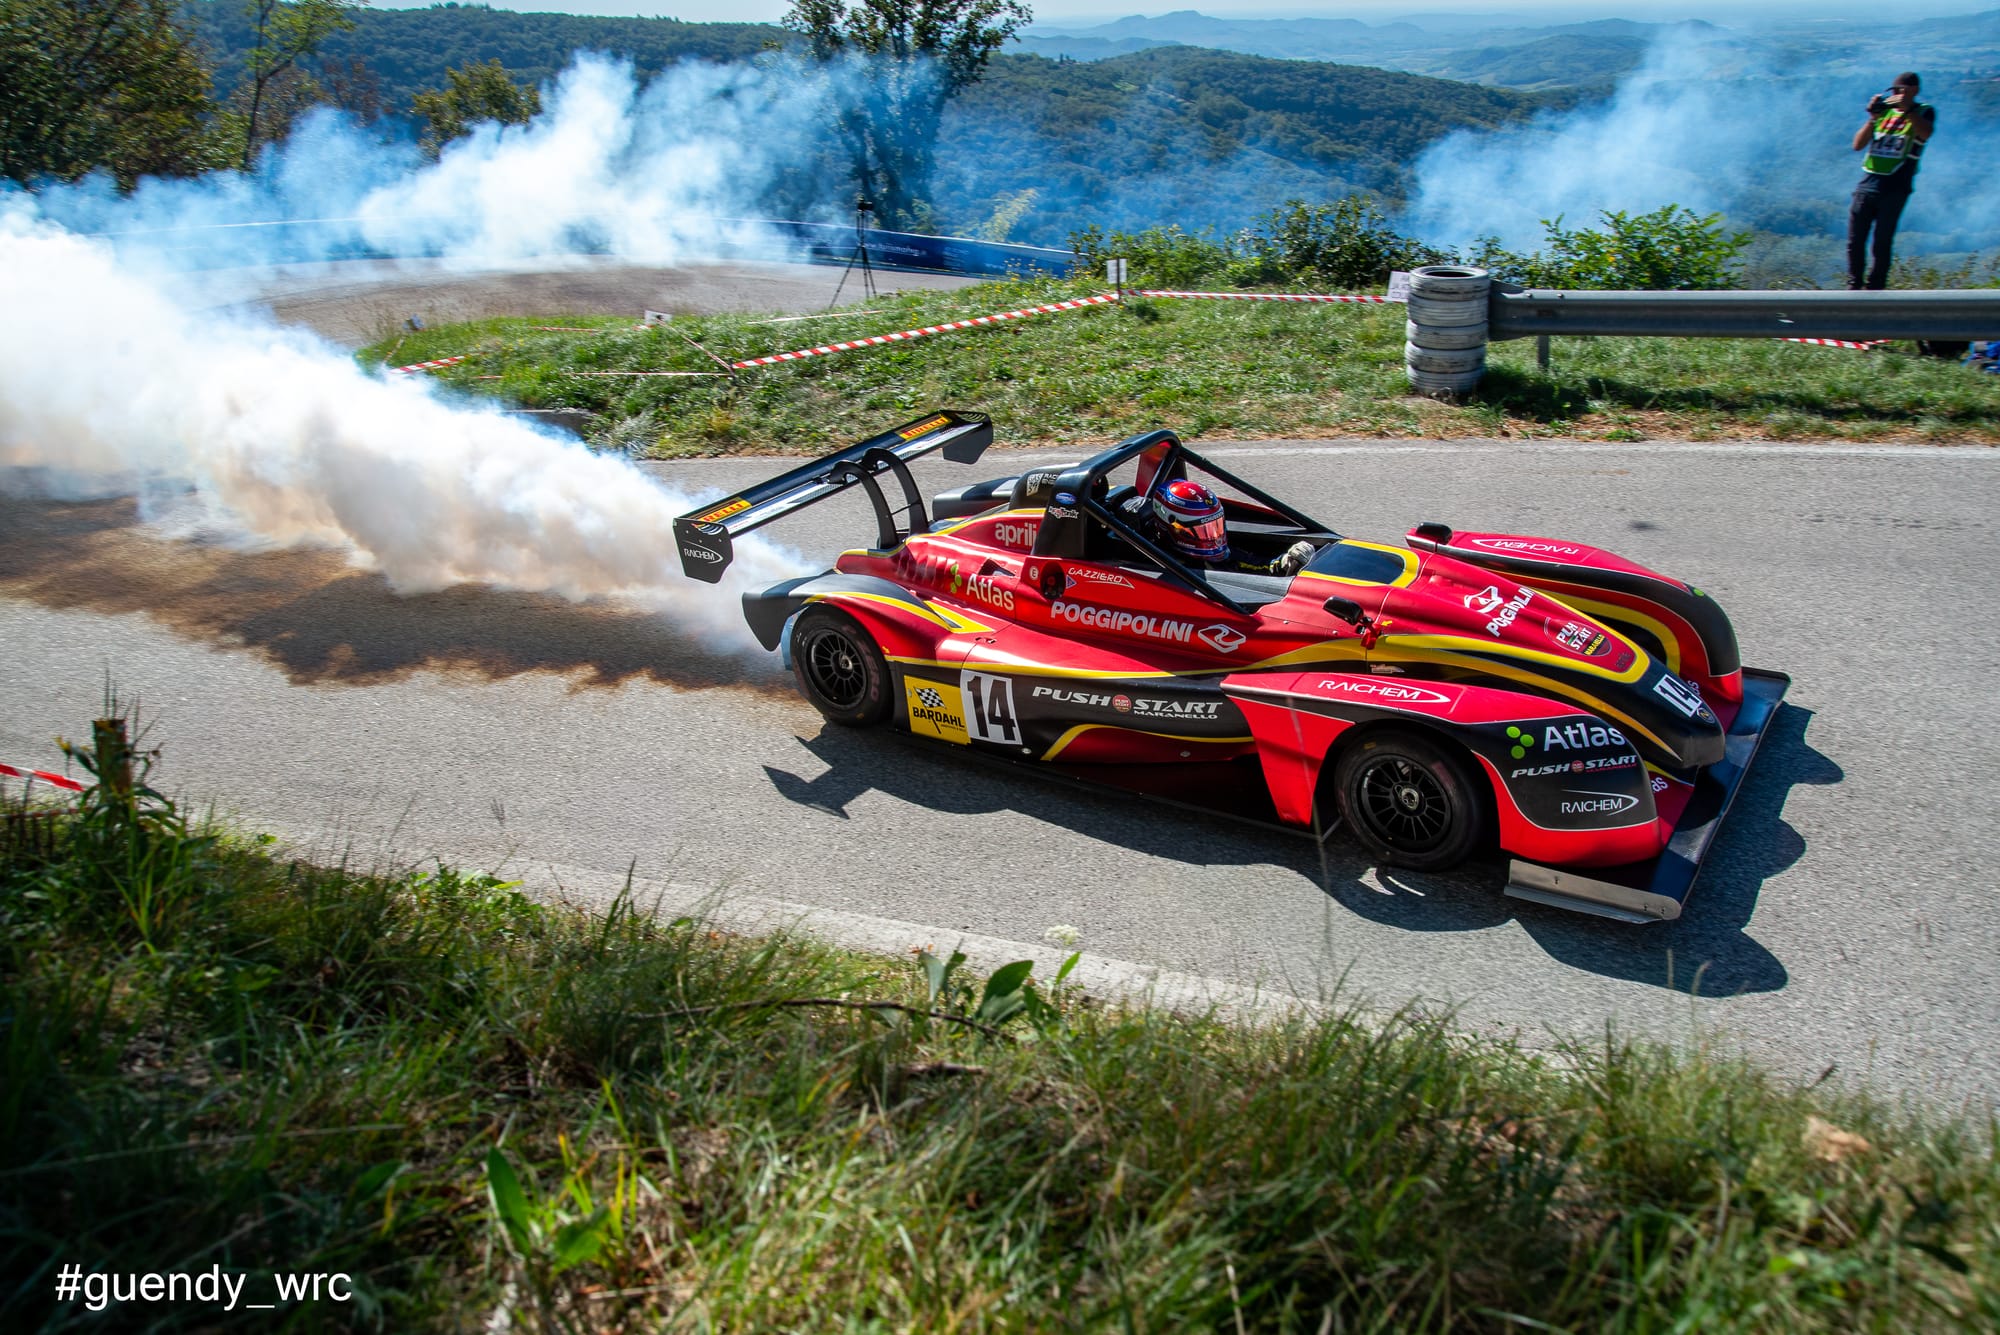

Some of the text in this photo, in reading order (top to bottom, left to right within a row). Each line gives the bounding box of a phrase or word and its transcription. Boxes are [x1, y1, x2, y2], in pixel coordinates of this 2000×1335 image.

[994, 521, 1037, 547] aprili
[683, 548, 715, 561] RAICHEM
[1494, 540, 1580, 555] RAICHEM
[1068, 567, 1123, 584] GAZZIERO
[966, 573, 1015, 611] Atlas
[1050, 600, 1195, 643] POGGIPOLINI
[1032, 686, 1112, 707] PUSH
[1133, 699, 1224, 714] START
[1317, 680, 1422, 700] RAICHEM
[1658, 677, 1699, 712] 14
[912, 706, 966, 729] BARDAHL
[966, 675, 1017, 741] 14
[1134, 710, 1218, 720] MARANELLO
[1543, 722, 1627, 752] Atlas
[1511, 763, 1571, 779] PUSH
[1584, 754, 1637, 770] START
[1561, 797, 1623, 814] RAICHEM
